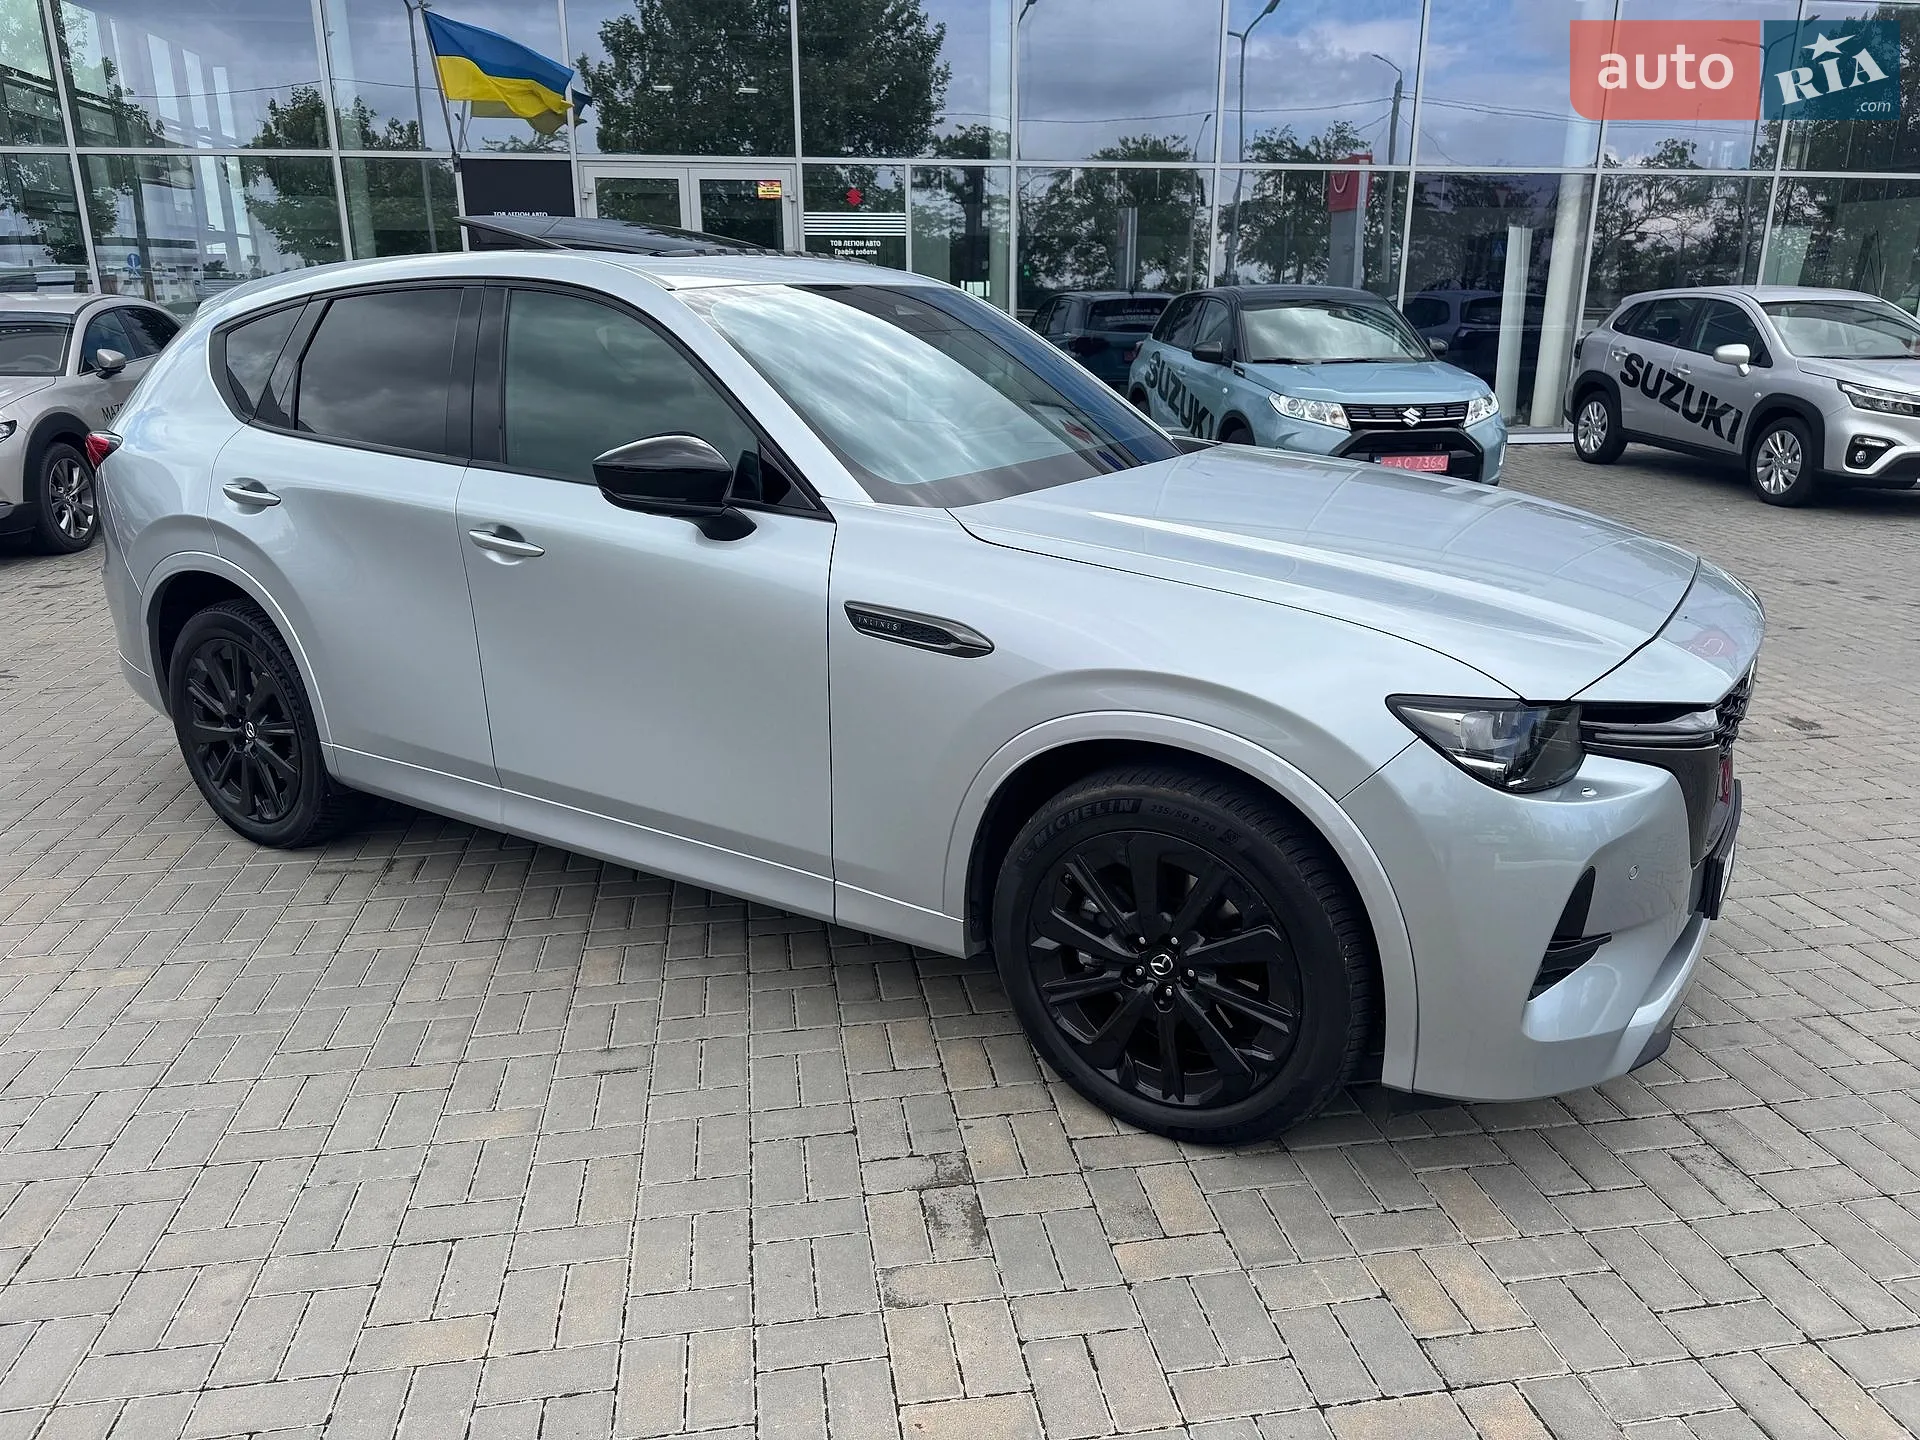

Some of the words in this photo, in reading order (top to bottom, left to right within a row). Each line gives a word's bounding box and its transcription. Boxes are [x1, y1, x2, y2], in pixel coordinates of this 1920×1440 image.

[1144, 351, 1214, 436] SUZUKI
[1619, 352, 1744, 445] SUZUKI
[1030, 798, 1138, 849] MICHELIN
